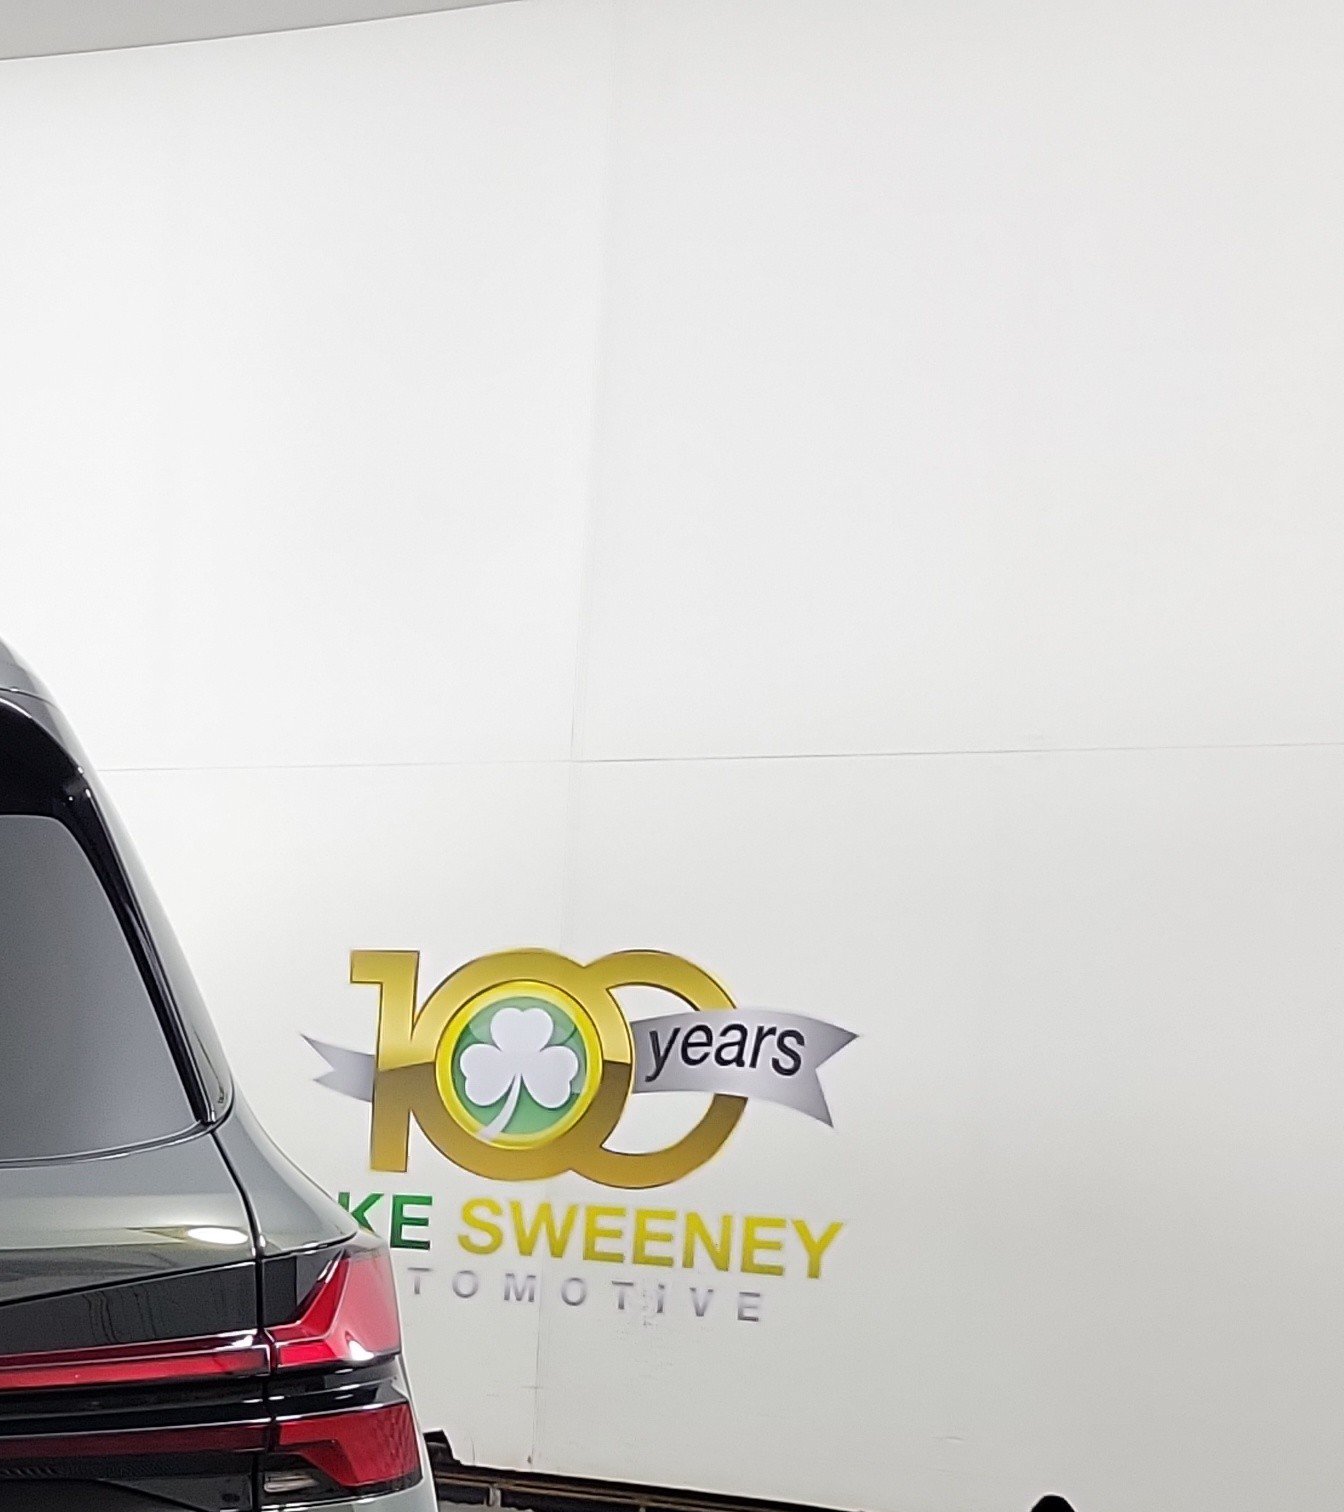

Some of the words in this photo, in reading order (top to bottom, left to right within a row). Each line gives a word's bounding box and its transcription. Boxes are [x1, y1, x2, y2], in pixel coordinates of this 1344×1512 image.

[350, 947, 748, 1189] 100
[645, 1022, 807, 1082] years
[337, 1191, 433, 1250] KE
[457, 1198, 844, 1279] SWEENEY
[406, 1267, 763, 1322] TOMOTIVE
